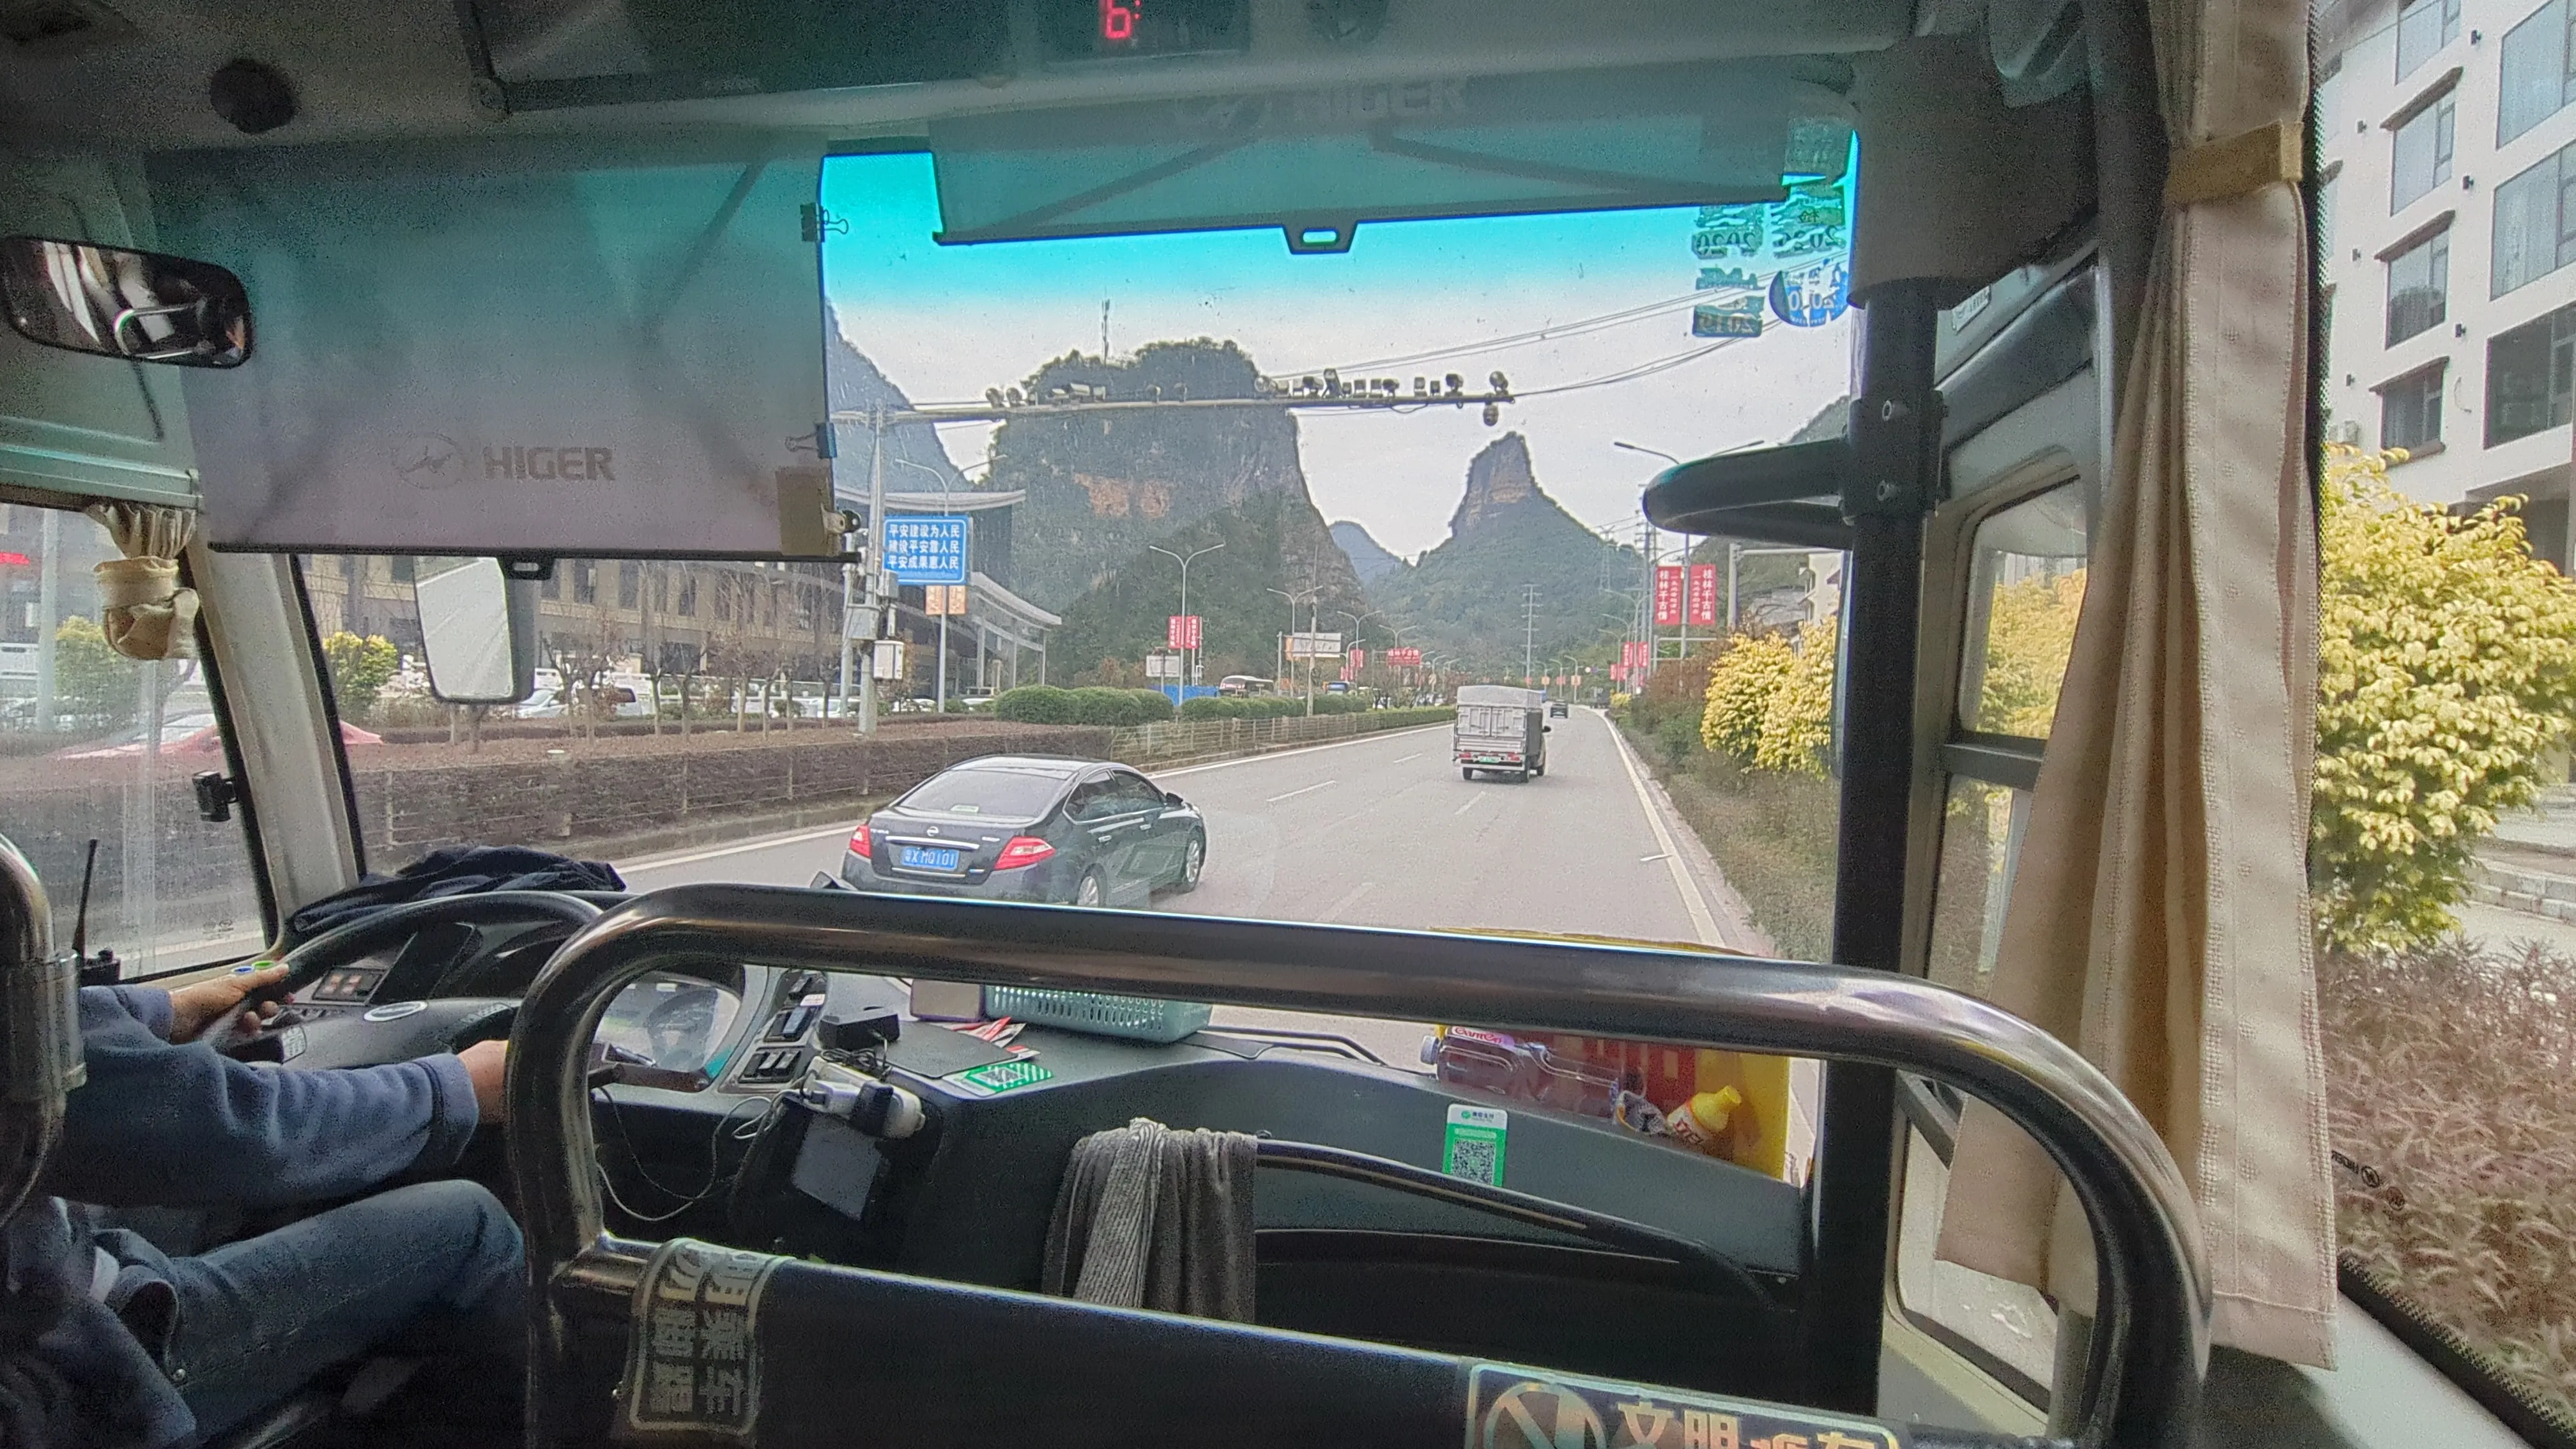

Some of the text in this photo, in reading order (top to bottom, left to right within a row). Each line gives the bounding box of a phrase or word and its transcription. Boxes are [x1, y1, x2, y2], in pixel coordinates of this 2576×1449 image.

[482, 446, 616, 481] HIGER
[889, 524, 960, 538] 平安建设为人民
[1617, 1400, 1876, 1449] 文明
